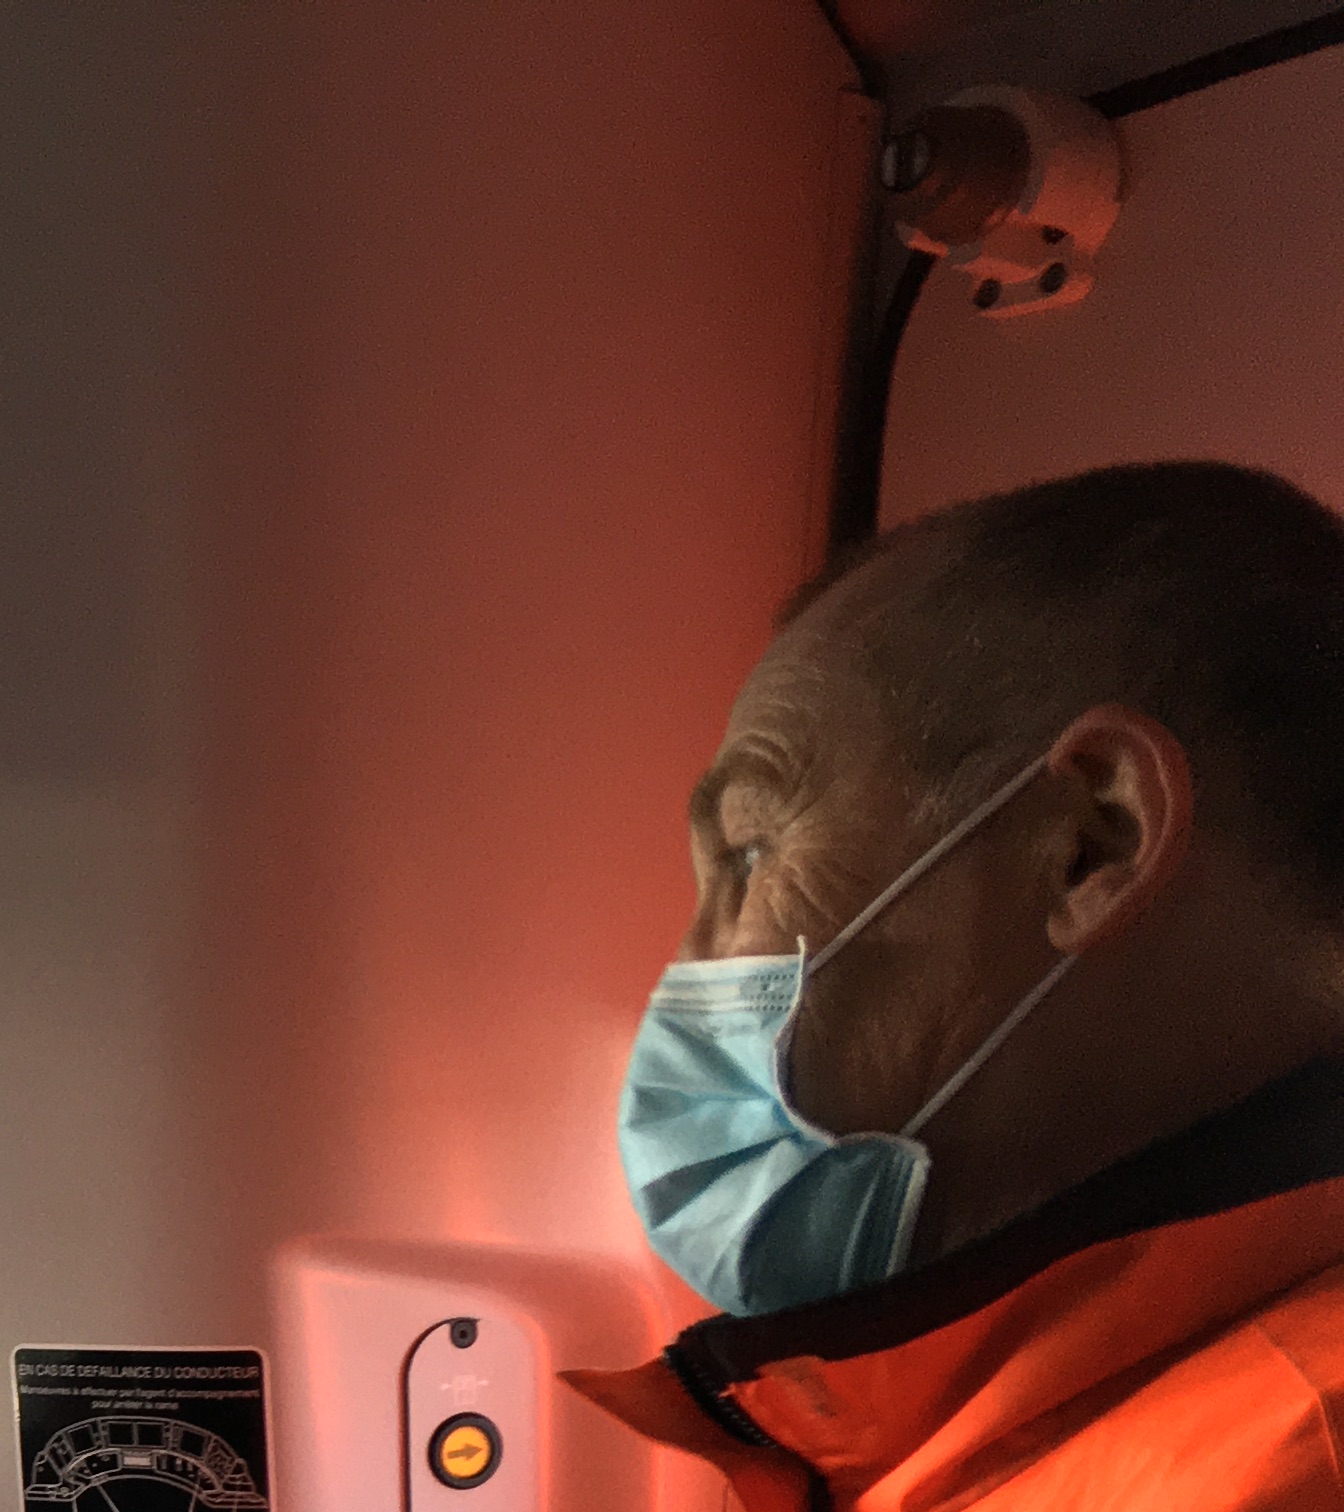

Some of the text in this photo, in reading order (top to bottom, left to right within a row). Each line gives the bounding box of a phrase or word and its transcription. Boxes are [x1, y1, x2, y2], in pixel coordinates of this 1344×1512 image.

[19, 1364, 260, 1379] EN CAS DE DEFAILLANCE DU CONDUCTEUR
